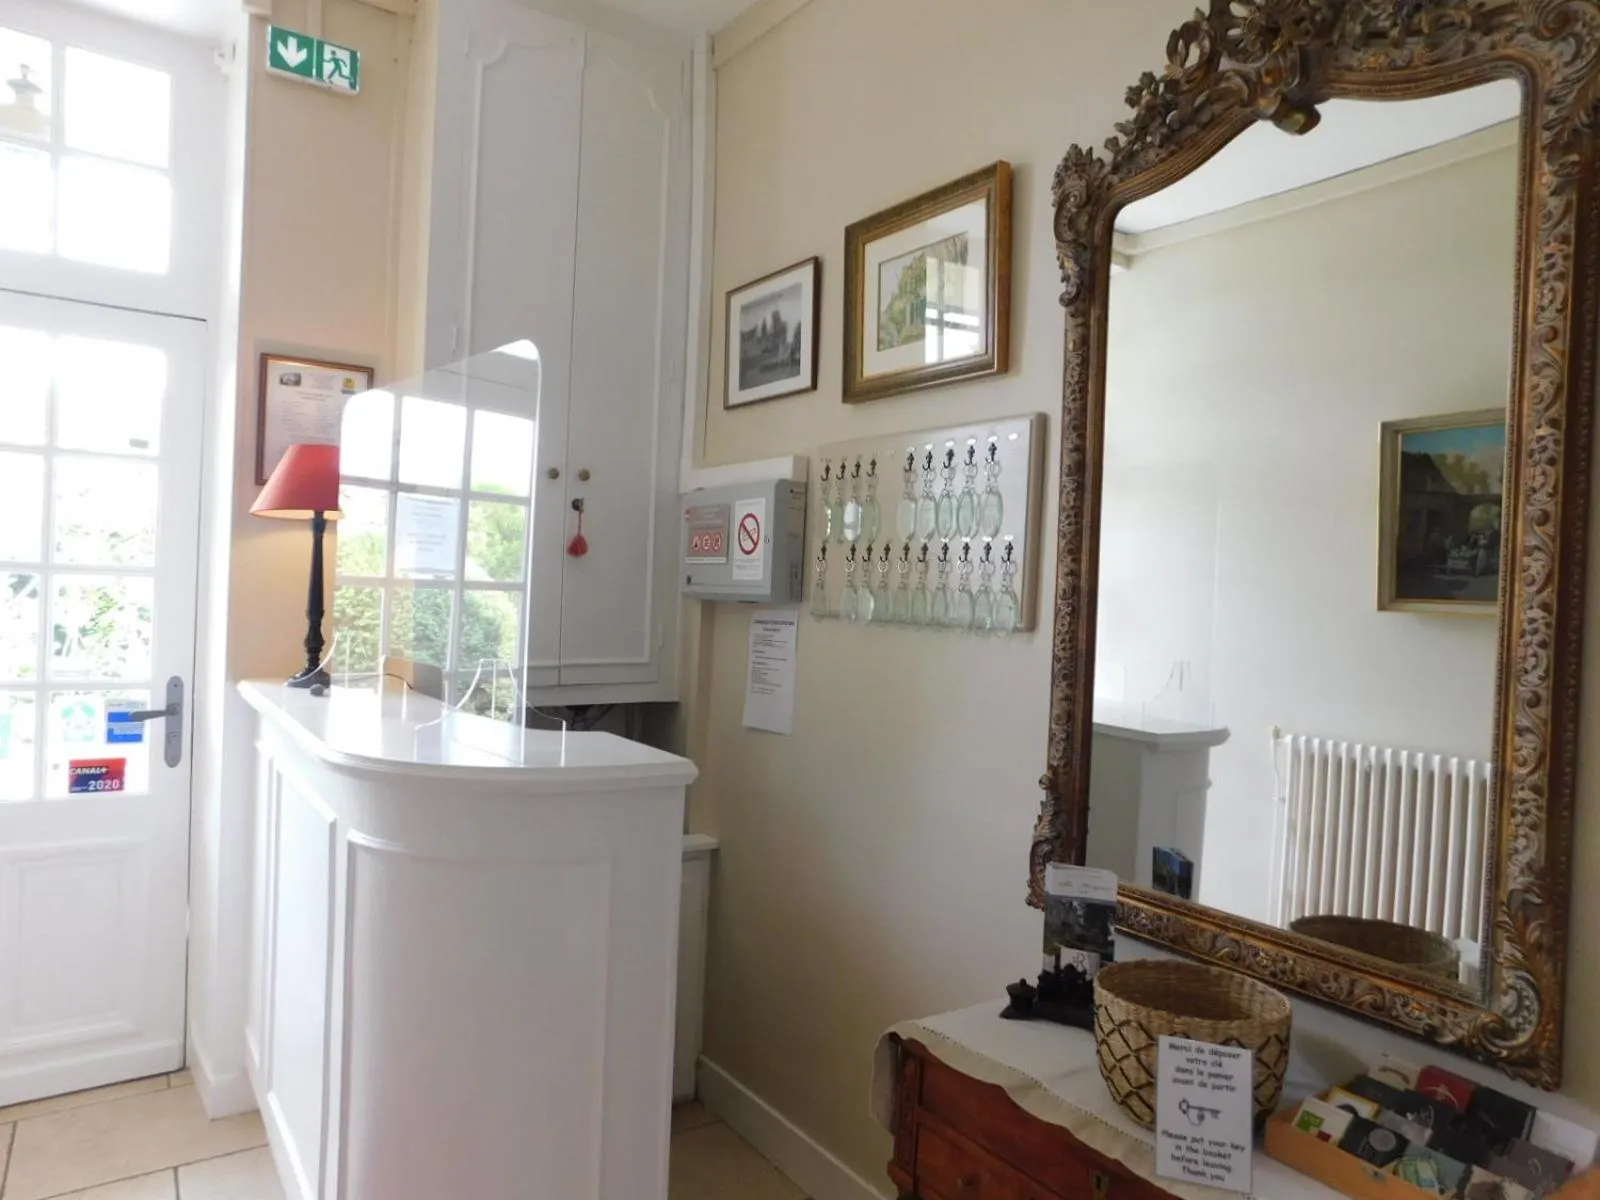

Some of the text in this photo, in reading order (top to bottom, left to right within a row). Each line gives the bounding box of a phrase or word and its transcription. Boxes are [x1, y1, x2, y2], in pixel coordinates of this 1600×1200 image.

[68, 767, 108, 776] CANAL+
[88, 779, 120, 791] 2020
[1169, 1042, 1241, 1060] Merci de déposer
[1186, 1057, 1222, 1068] votre clé
[1175, 1066, 1234, 1081] dans le panier
[1172, 1077, 1194, 1085] avant
[1198, 1080, 1207, 1088] de
[1161, 1129, 1245, 1152] Please put your key
[1185, 1145, 1199, 1153] the
[1203, 1147, 1232, 1159] basket
[1170, 1152, 1232, 1173] before leaving
[1182, 1165, 1225, 1182] Thank you
